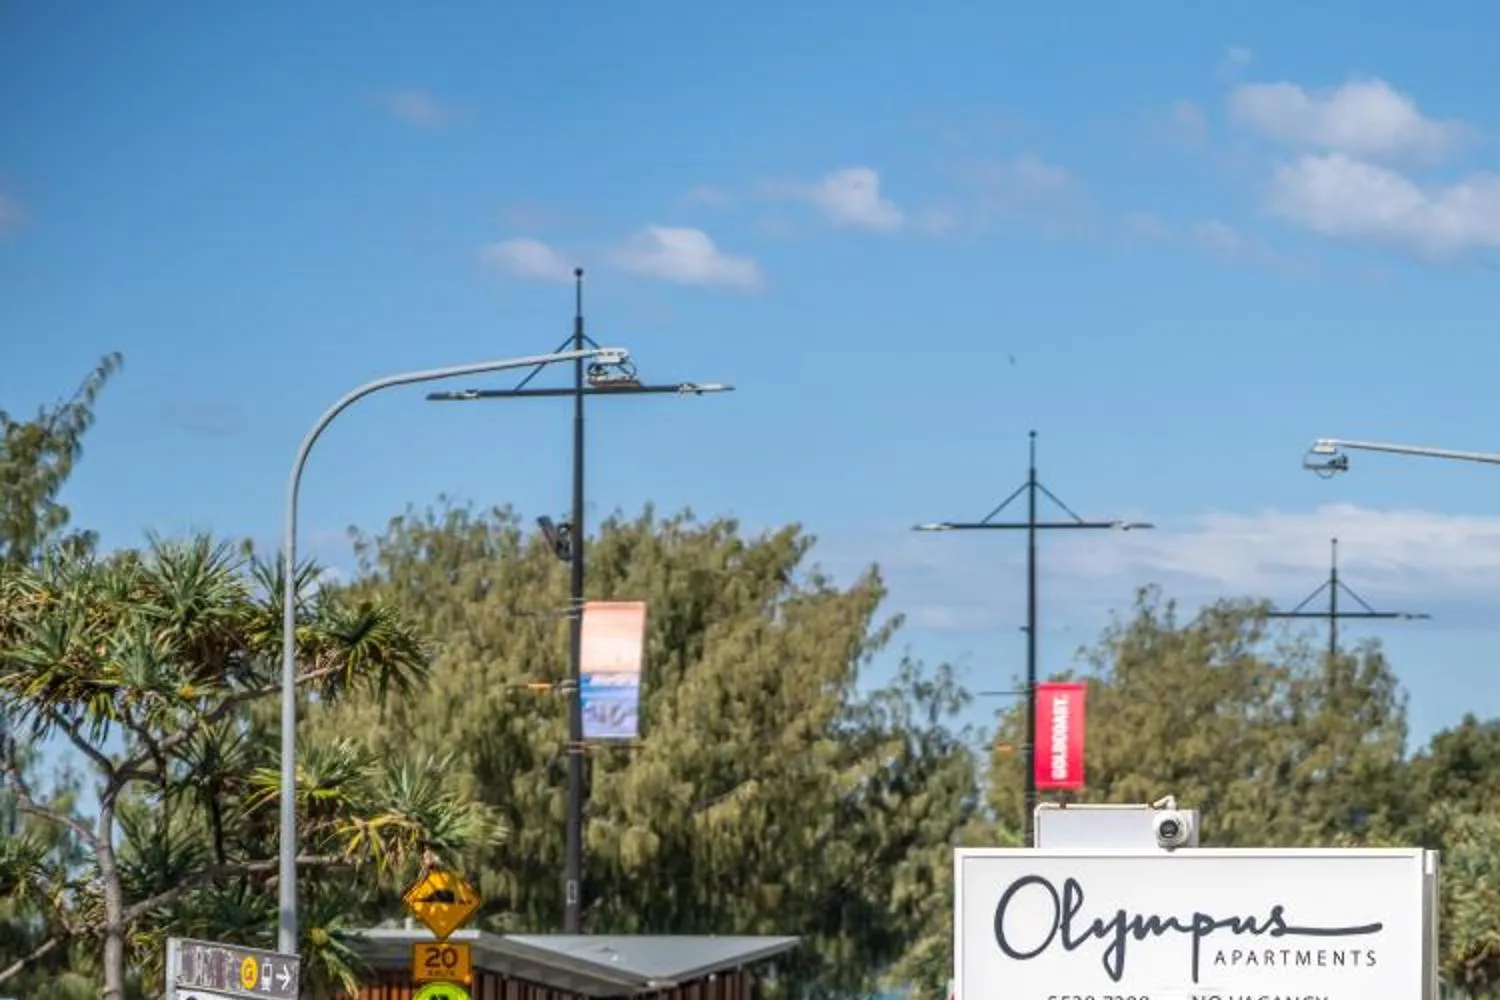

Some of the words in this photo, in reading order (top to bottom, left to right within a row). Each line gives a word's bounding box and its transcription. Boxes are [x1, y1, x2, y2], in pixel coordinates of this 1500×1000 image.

[994, 874, 1384, 983] Olympus
[424, 947, 458, 969] 20
[1213, 949, 1379, 967] APARTMENTS
